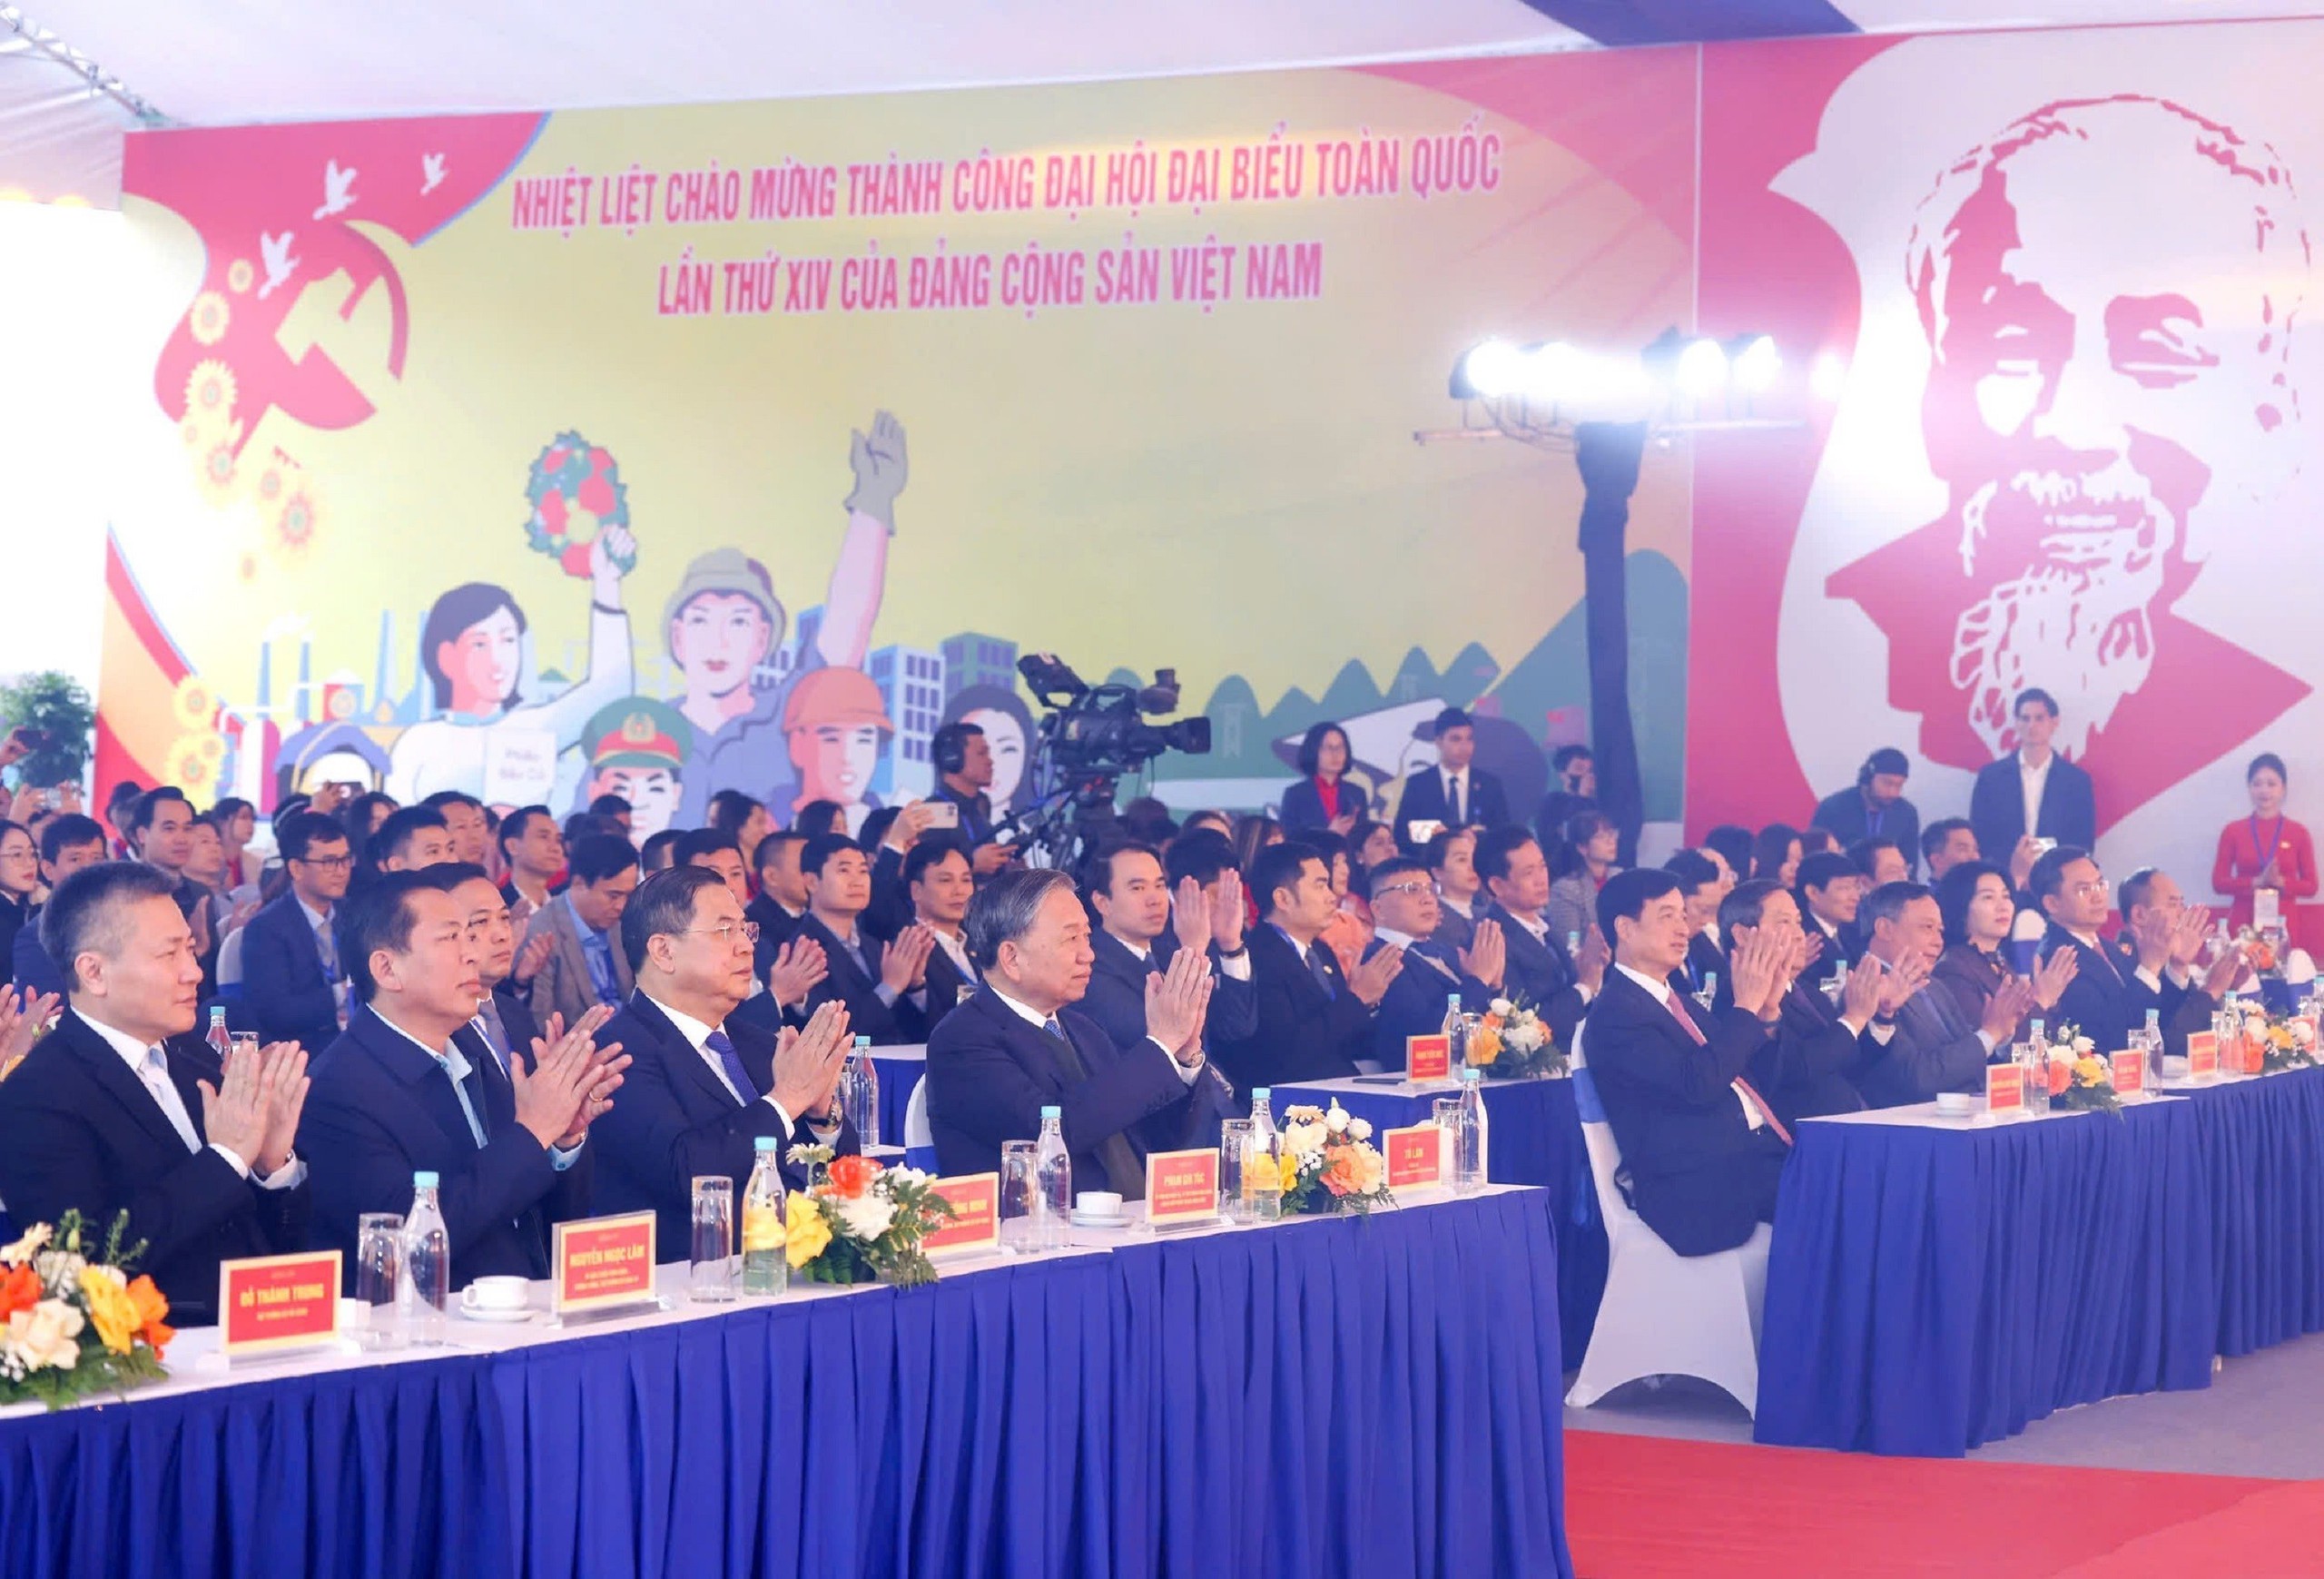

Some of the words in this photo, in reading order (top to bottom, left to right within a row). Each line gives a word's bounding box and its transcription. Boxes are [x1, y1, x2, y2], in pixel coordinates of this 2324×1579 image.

[512, 165, 593, 240] NHIỆT
[600, 163, 658, 236] LIỆT
[665, 159, 740, 223] CHÀO
[749, 155, 837, 220] MỪNG
[847, 151, 943, 216] THÀNH
[953, 146, 1035, 212] CÔNG
[1045, 154, 1095, 221] ĐẠI
[1105, 140, 1157, 218] HỘI
[1167, 148, 1220, 216] ĐẠI
[1230, 120, 1304, 200] BIỂU
[1316, 126, 1400, 197] TOÀN
[1412, 113, 1501, 199] QUỐC
[658, 244, 714, 314] LẦN
[724, 249, 782, 314] THỨ
[783, 257, 832, 311] XIV
[841, 238, 898, 311] CỦA
[909, 237, 991, 309] ĐẢNG
[1001, 240, 1085, 319] CỘNG
[1095, 231, 1159, 303] SẢN
[1170, 233, 1236, 313] VIỆT
[1246, 242, 1323, 300] NAM
